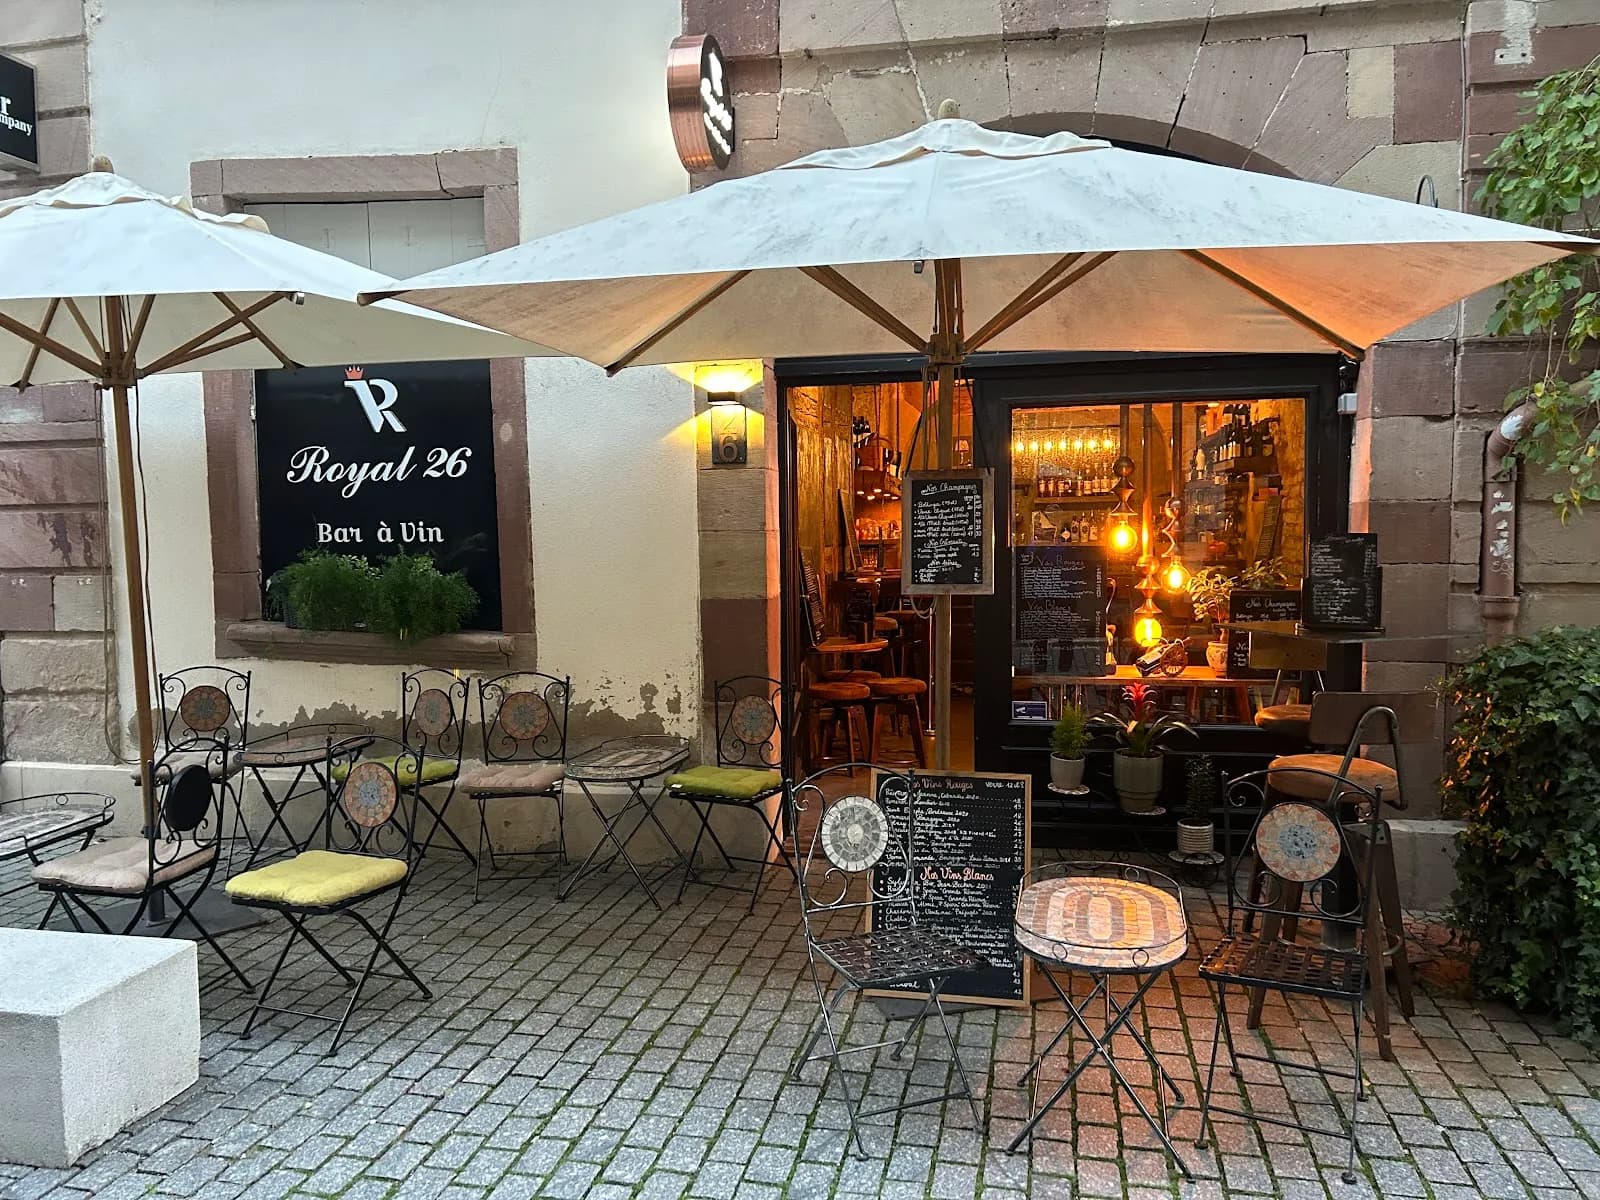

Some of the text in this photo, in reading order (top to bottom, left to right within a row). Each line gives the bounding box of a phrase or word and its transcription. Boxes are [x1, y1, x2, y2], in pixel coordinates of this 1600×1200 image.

[286, 446, 473, 498] Royal 26
[317, 521, 444, 543] Bar à Vin
[919, 866, 995, 882] Nos Vins Blancs
